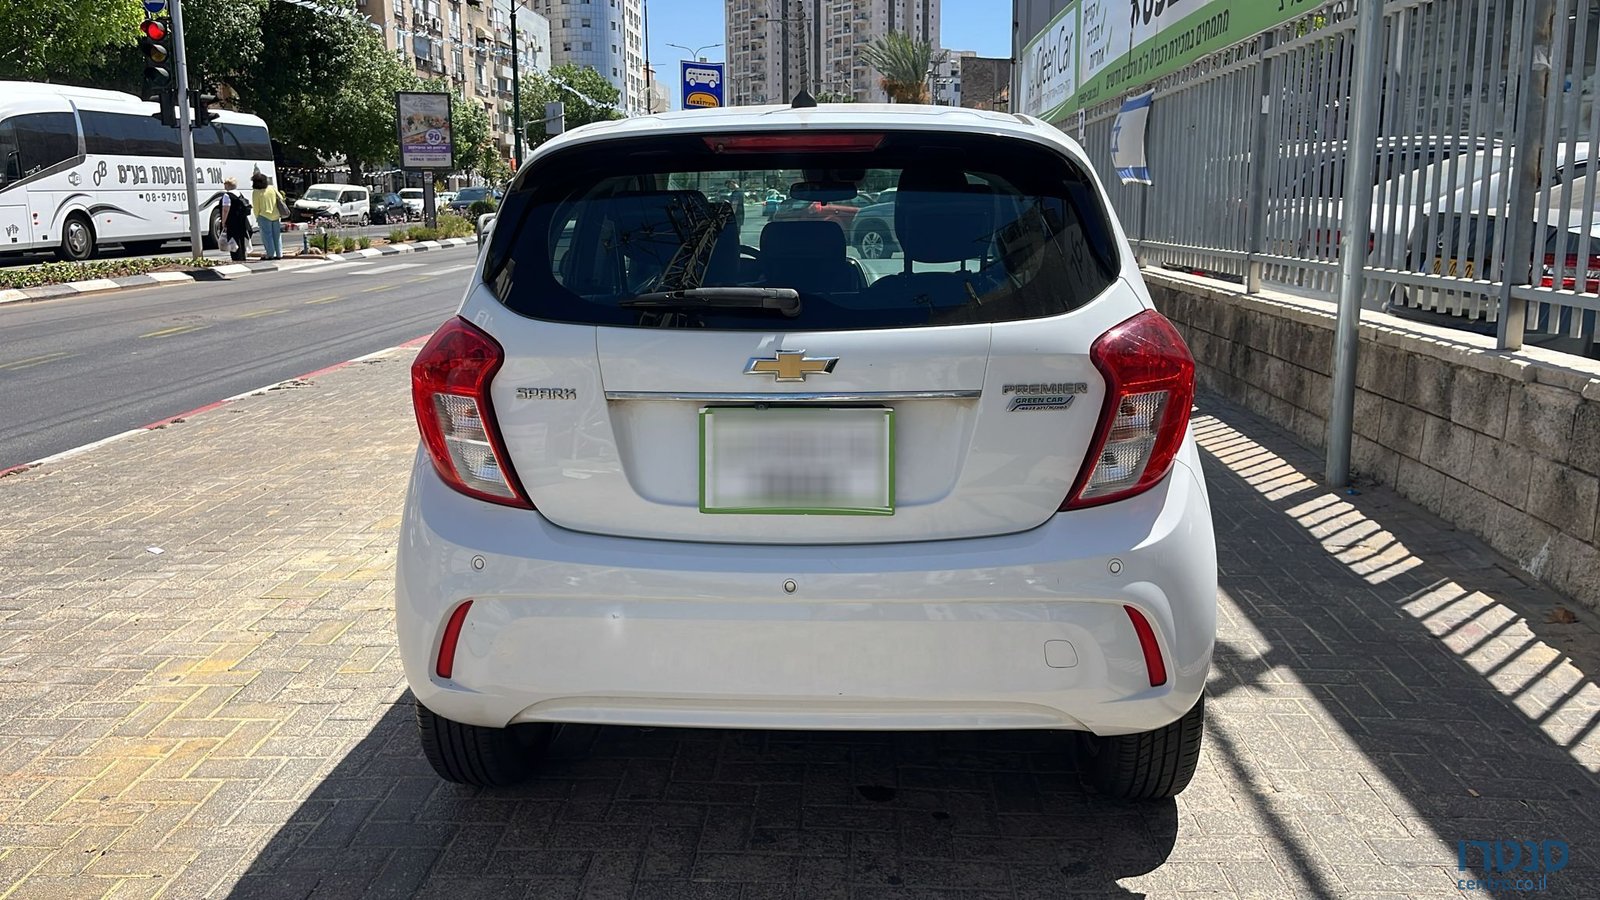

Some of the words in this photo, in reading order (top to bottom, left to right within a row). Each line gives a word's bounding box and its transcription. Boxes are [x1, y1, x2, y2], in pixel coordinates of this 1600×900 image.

[1195, 8, 1229, 46] מתמחים
[1058, 25, 1074, 74] Car
[1168, 29, 1194, 60] במכירת
[428, 133, 440, 141] 90
[151, 166, 184, 185] הסעות
[207, 167, 224, 184] אור
[145, 192, 186, 202] 08-97910
[516, 387, 577, 400] SPARK
[1002, 382, 1088, 395] PREMIER
